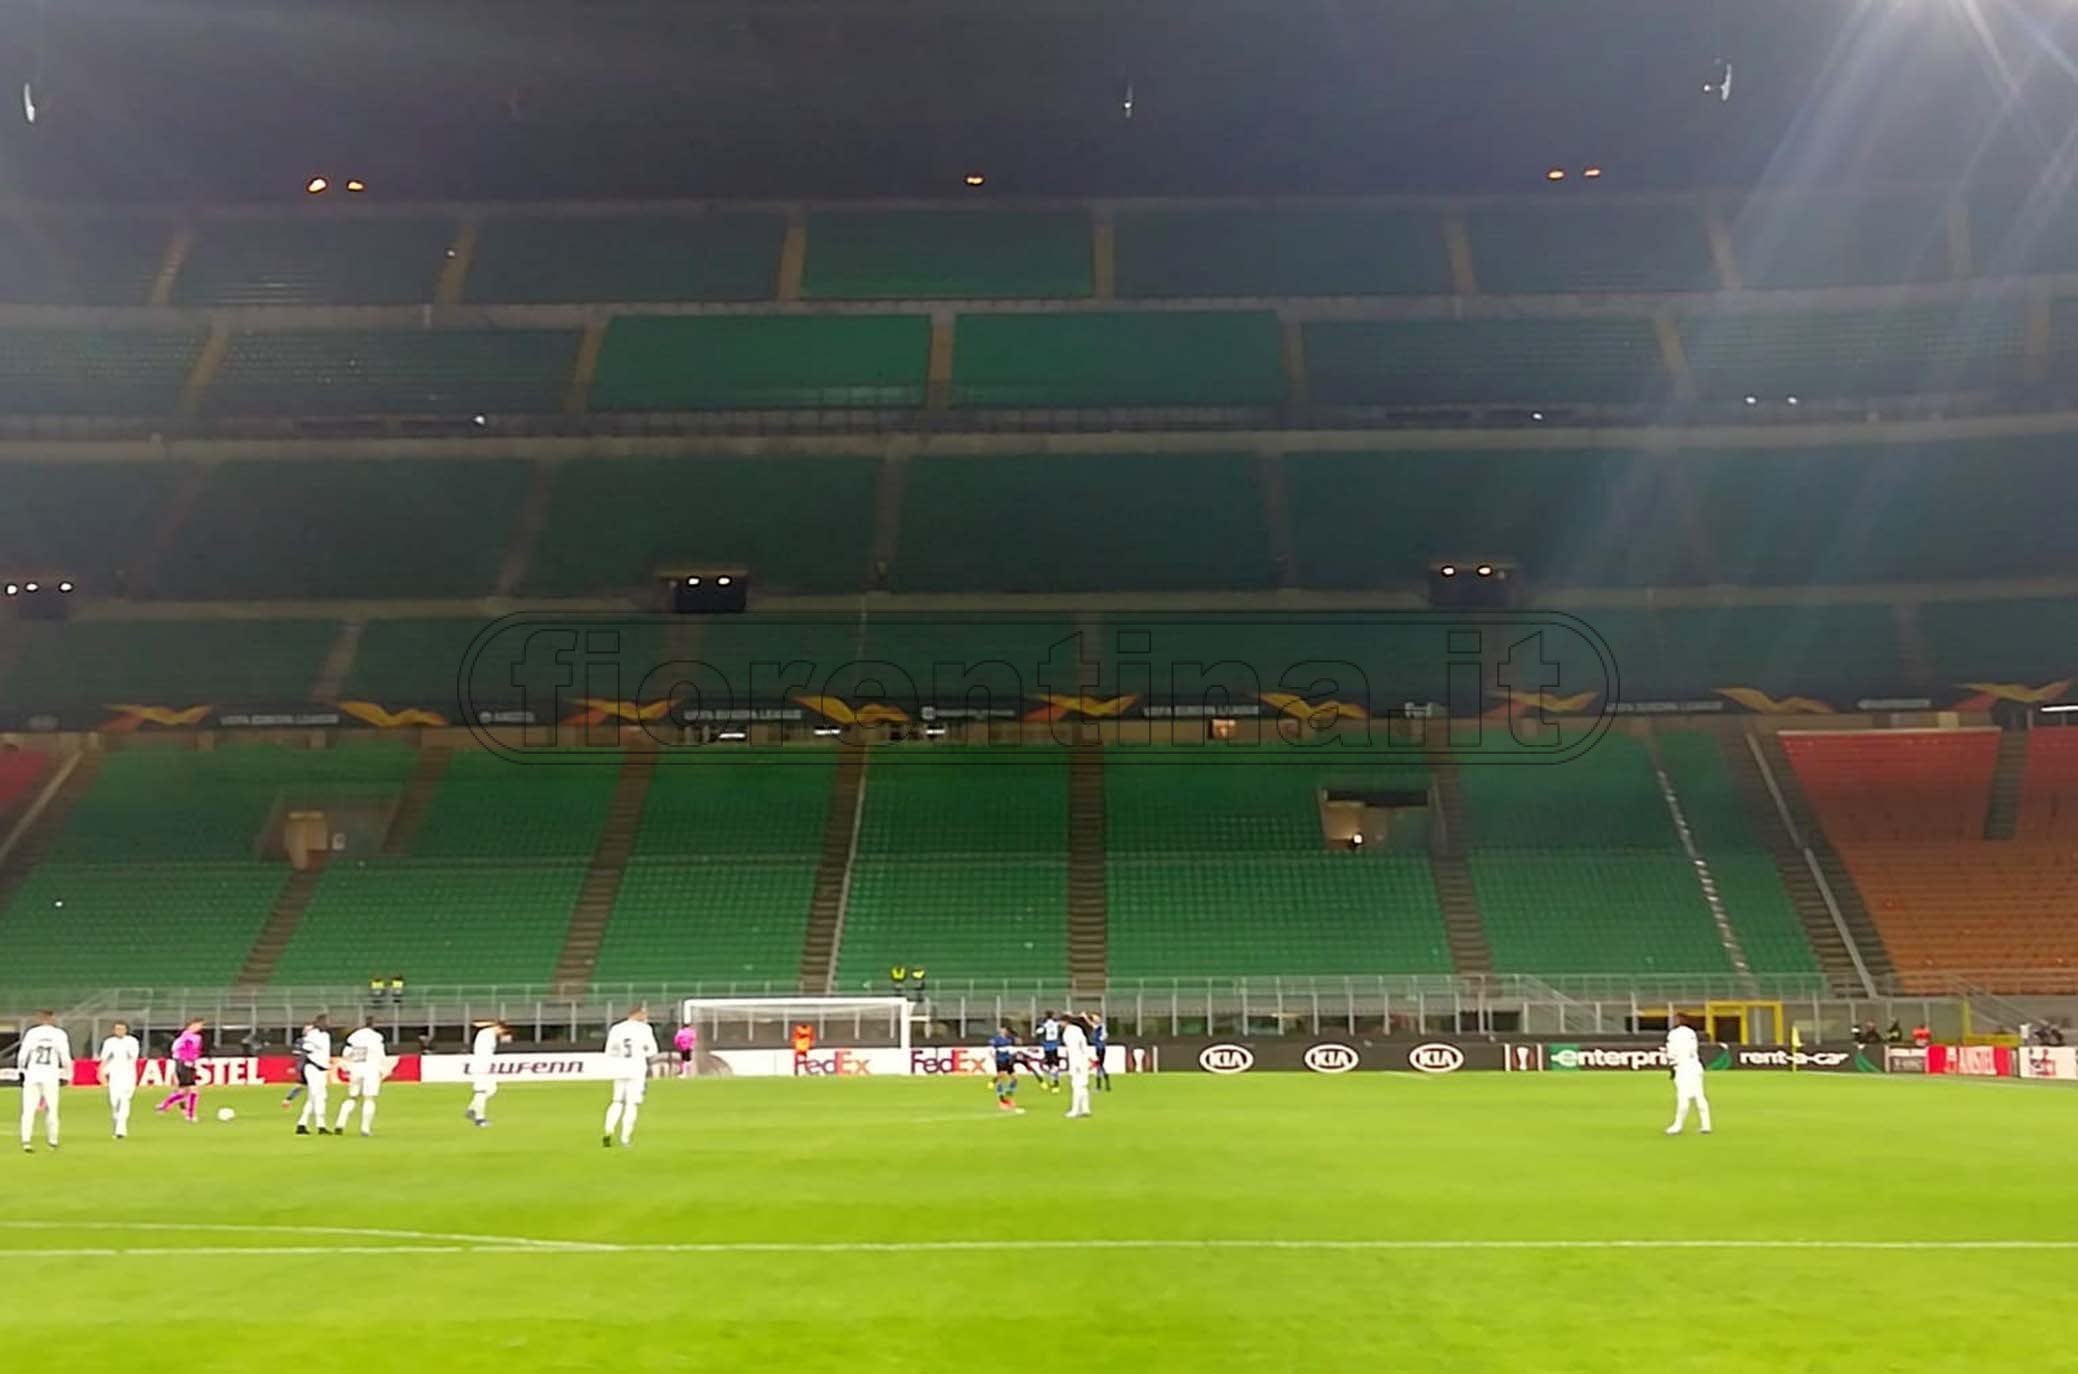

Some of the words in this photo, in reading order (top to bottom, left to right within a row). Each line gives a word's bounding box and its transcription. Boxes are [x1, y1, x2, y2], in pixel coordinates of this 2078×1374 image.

[794, 1049, 870, 1076] FedEx
[910, 1049, 986, 1075] FedEx
[1209, 1051, 1245, 1068] KIA
[1314, 1050, 1350, 1067] KIA
[1418, 1050, 1455, 1067] KIA
[1740, 1049, 1849, 1065] rent-a-car
